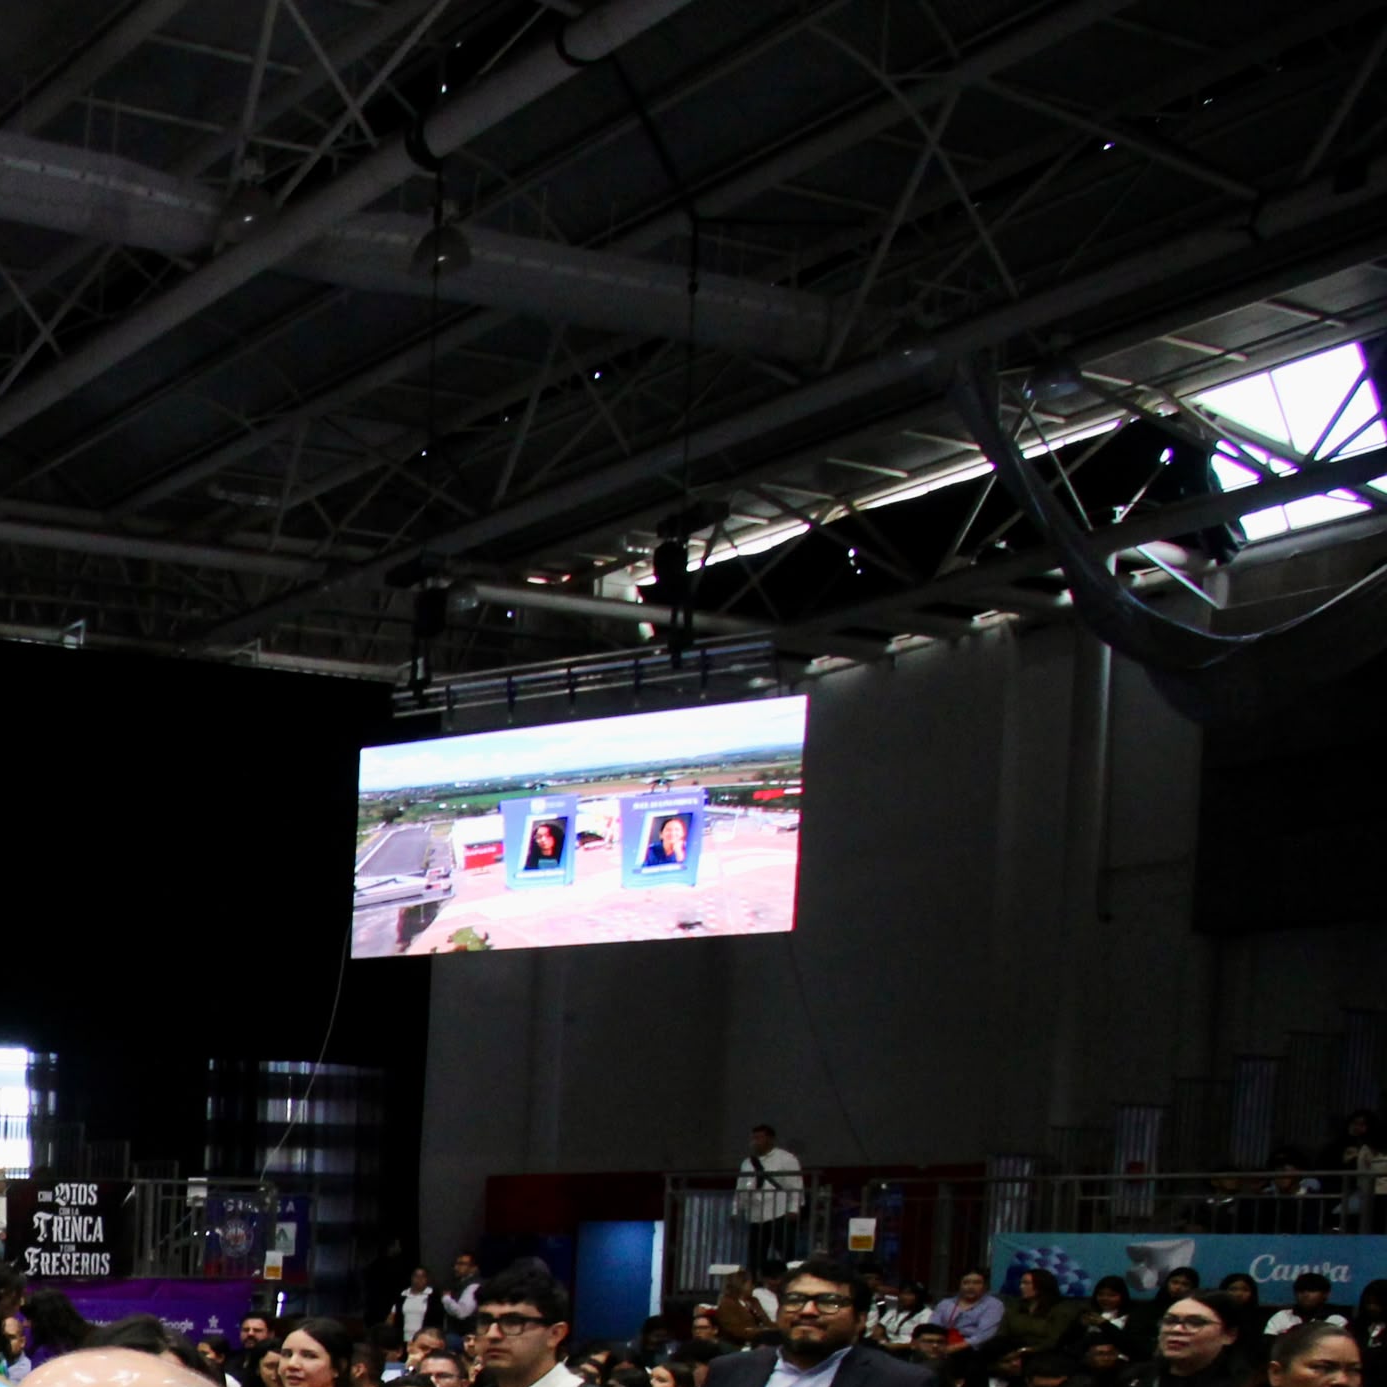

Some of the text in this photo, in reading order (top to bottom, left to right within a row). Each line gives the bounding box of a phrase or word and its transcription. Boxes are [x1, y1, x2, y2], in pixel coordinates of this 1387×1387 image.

[54, 1182, 99, 1206] DIOS
[32, 1211, 104, 1243] TRINCA
[24, 1246, 111, 1276] FRESEROS
